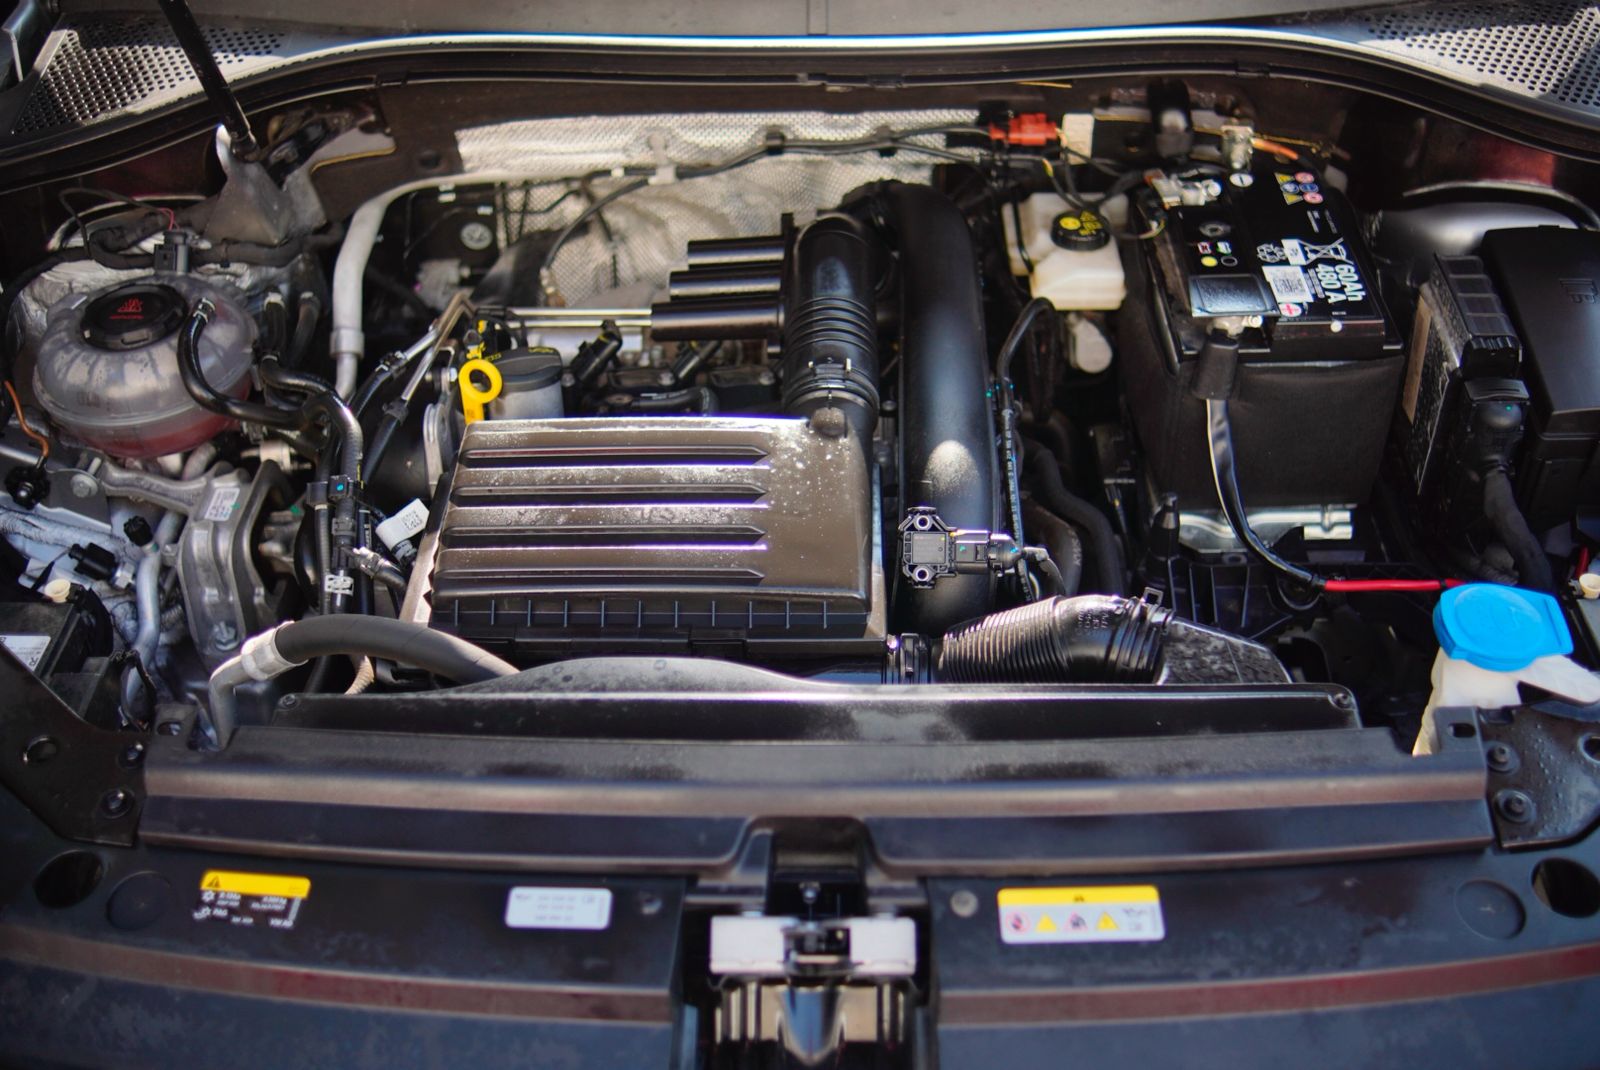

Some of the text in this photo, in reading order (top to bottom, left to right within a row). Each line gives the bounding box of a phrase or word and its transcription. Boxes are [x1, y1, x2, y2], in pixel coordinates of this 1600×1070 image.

[1316, 264, 1342, 289] 480
[1335, 264, 1366, 301] 60Ah
[1325, 291, 1347, 303] A
